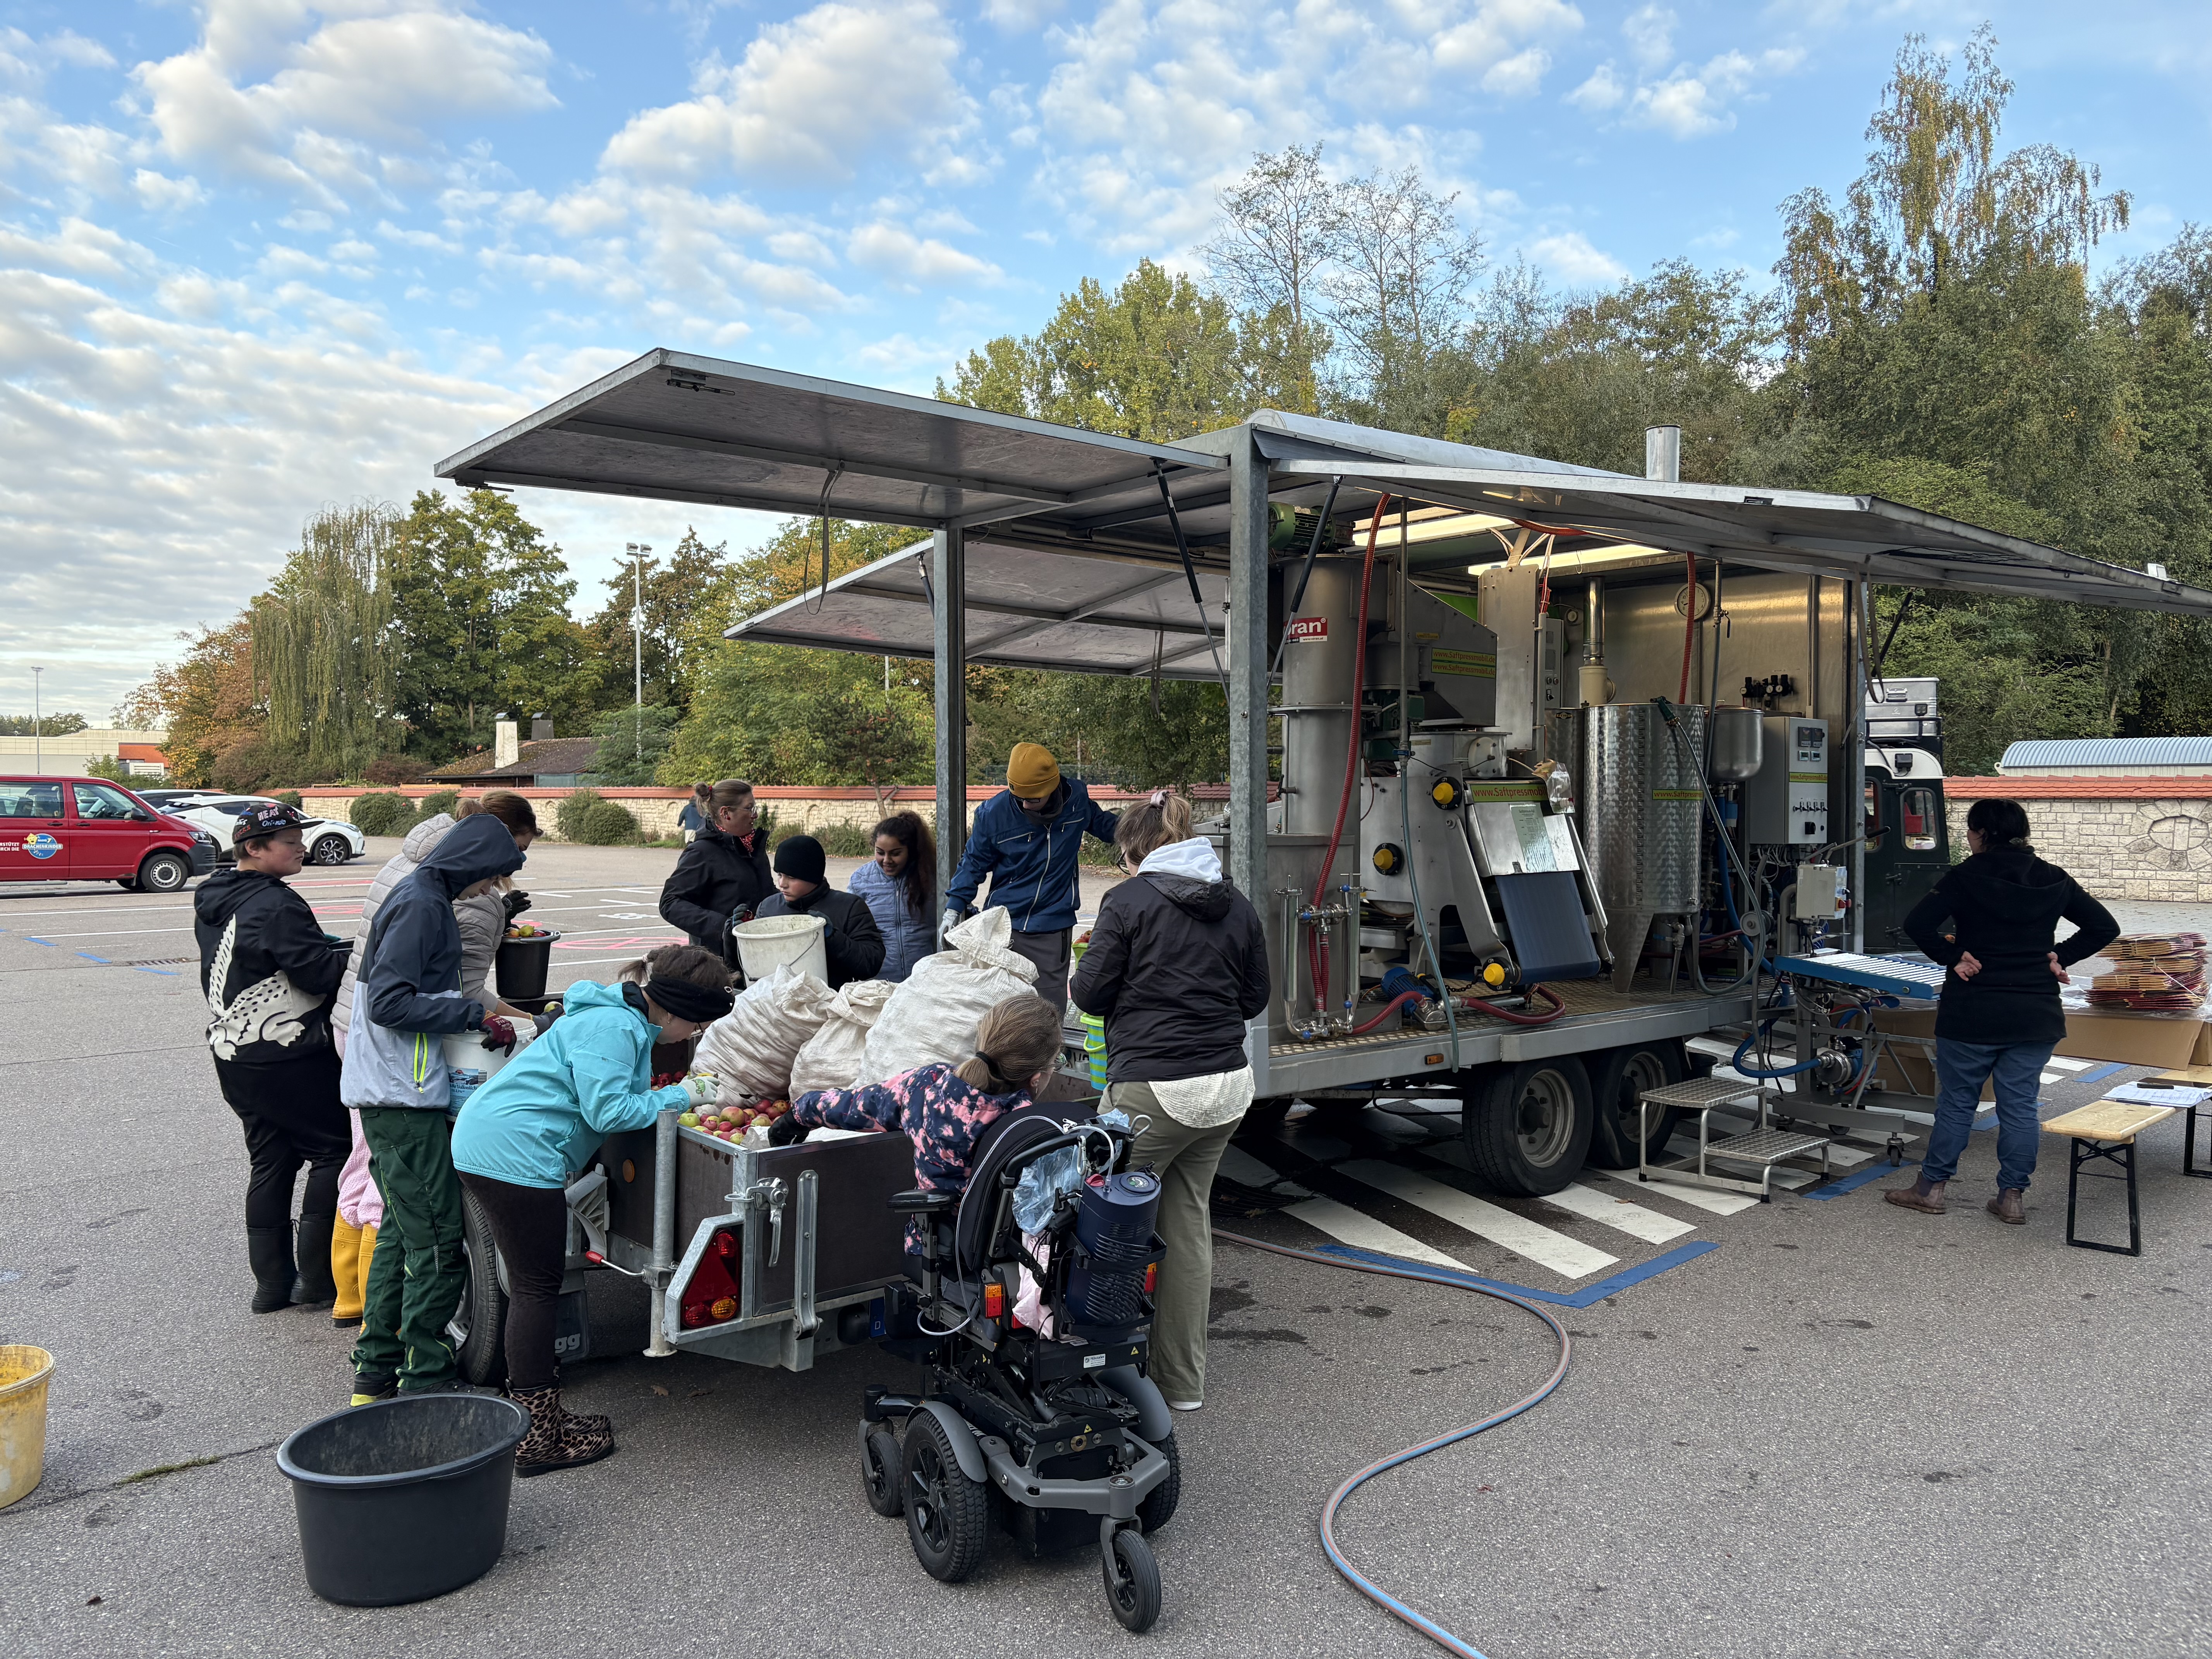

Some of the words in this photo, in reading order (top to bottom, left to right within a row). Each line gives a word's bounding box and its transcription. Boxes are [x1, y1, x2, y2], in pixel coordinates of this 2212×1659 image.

[1433, 651, 1496, 663] www.Saftpressmobil.de
[1433, 664, 1495, 675] www.Saftpressmobil.de
[258, 806, 279, 821] HEAT
[875, 1321, 881, 1330] D
